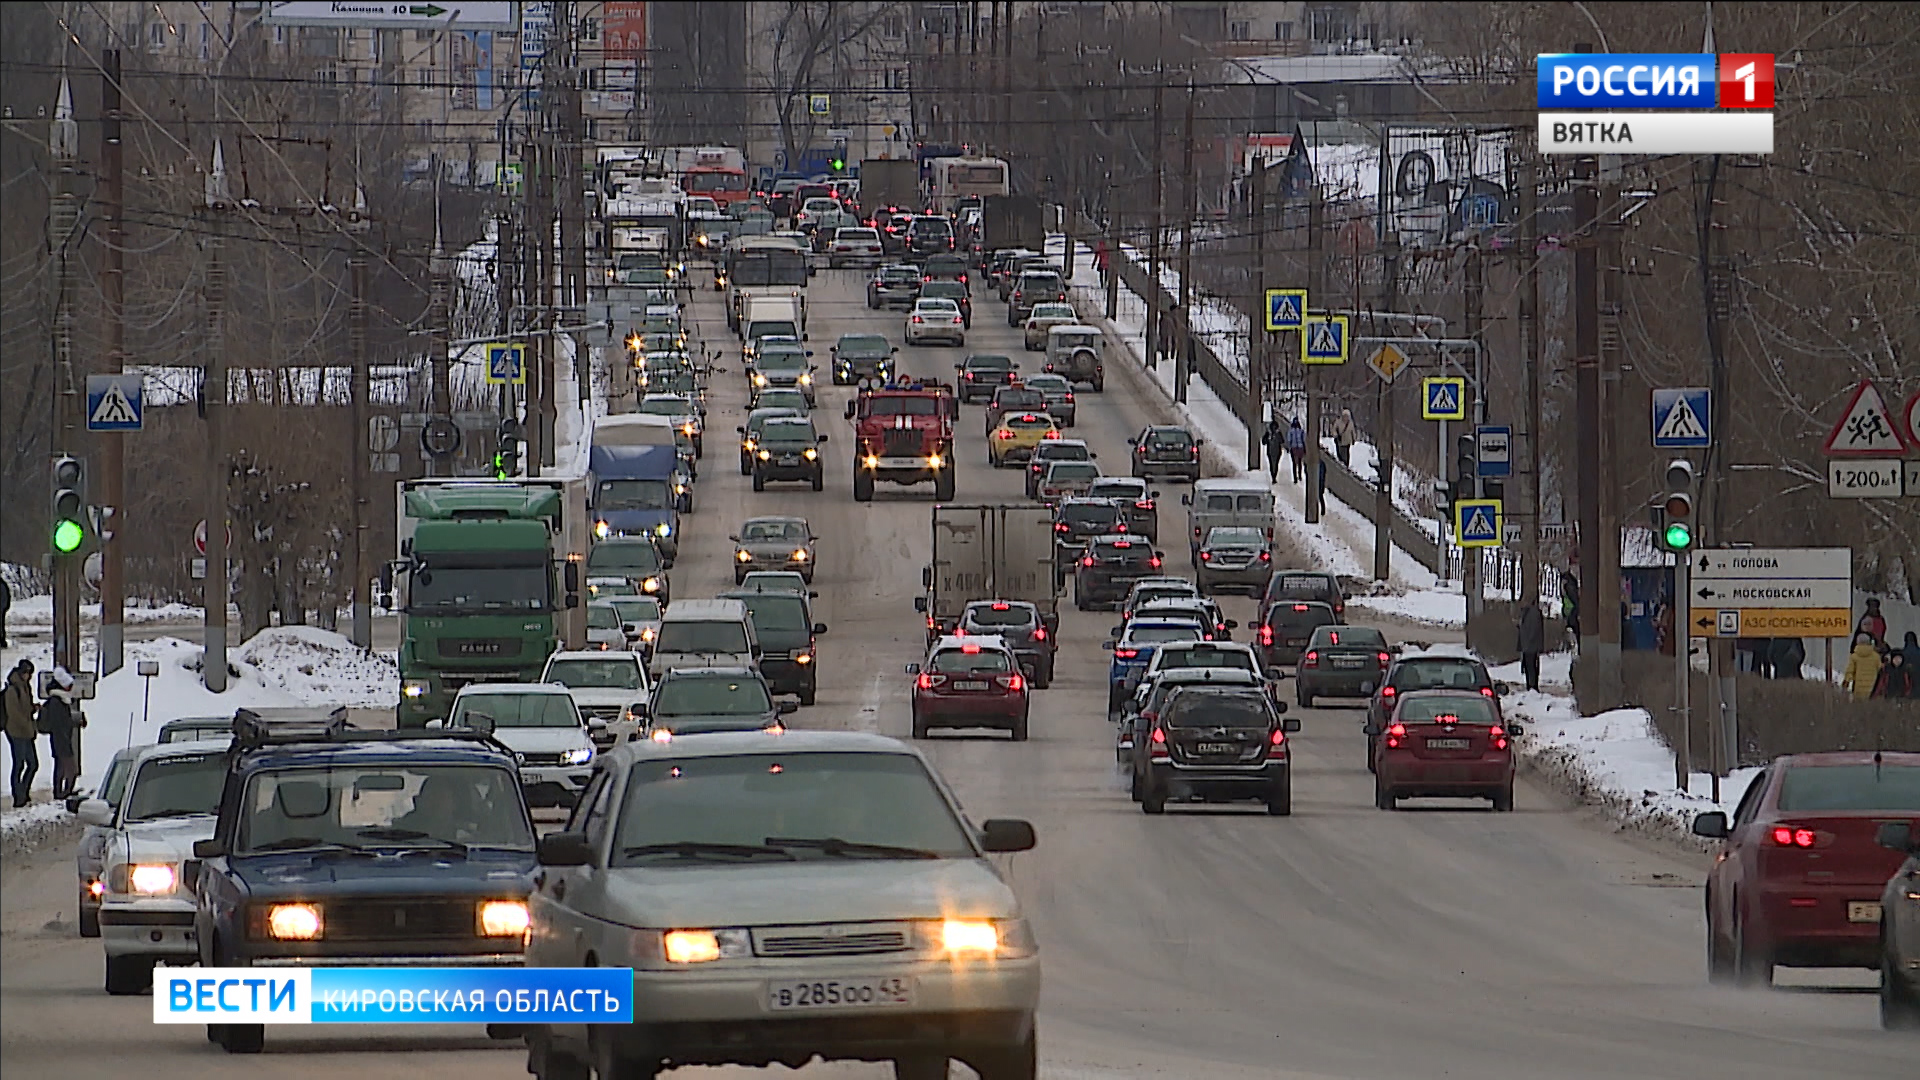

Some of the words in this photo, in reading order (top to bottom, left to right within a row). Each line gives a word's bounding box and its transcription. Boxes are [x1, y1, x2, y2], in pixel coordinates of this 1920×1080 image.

[1732, 557, 1779, 569] ПОПОВА
[1732, 588, 1812, 599] МОСКОВСКАЯ
[1744, 617, 1767, 628] АЗС
